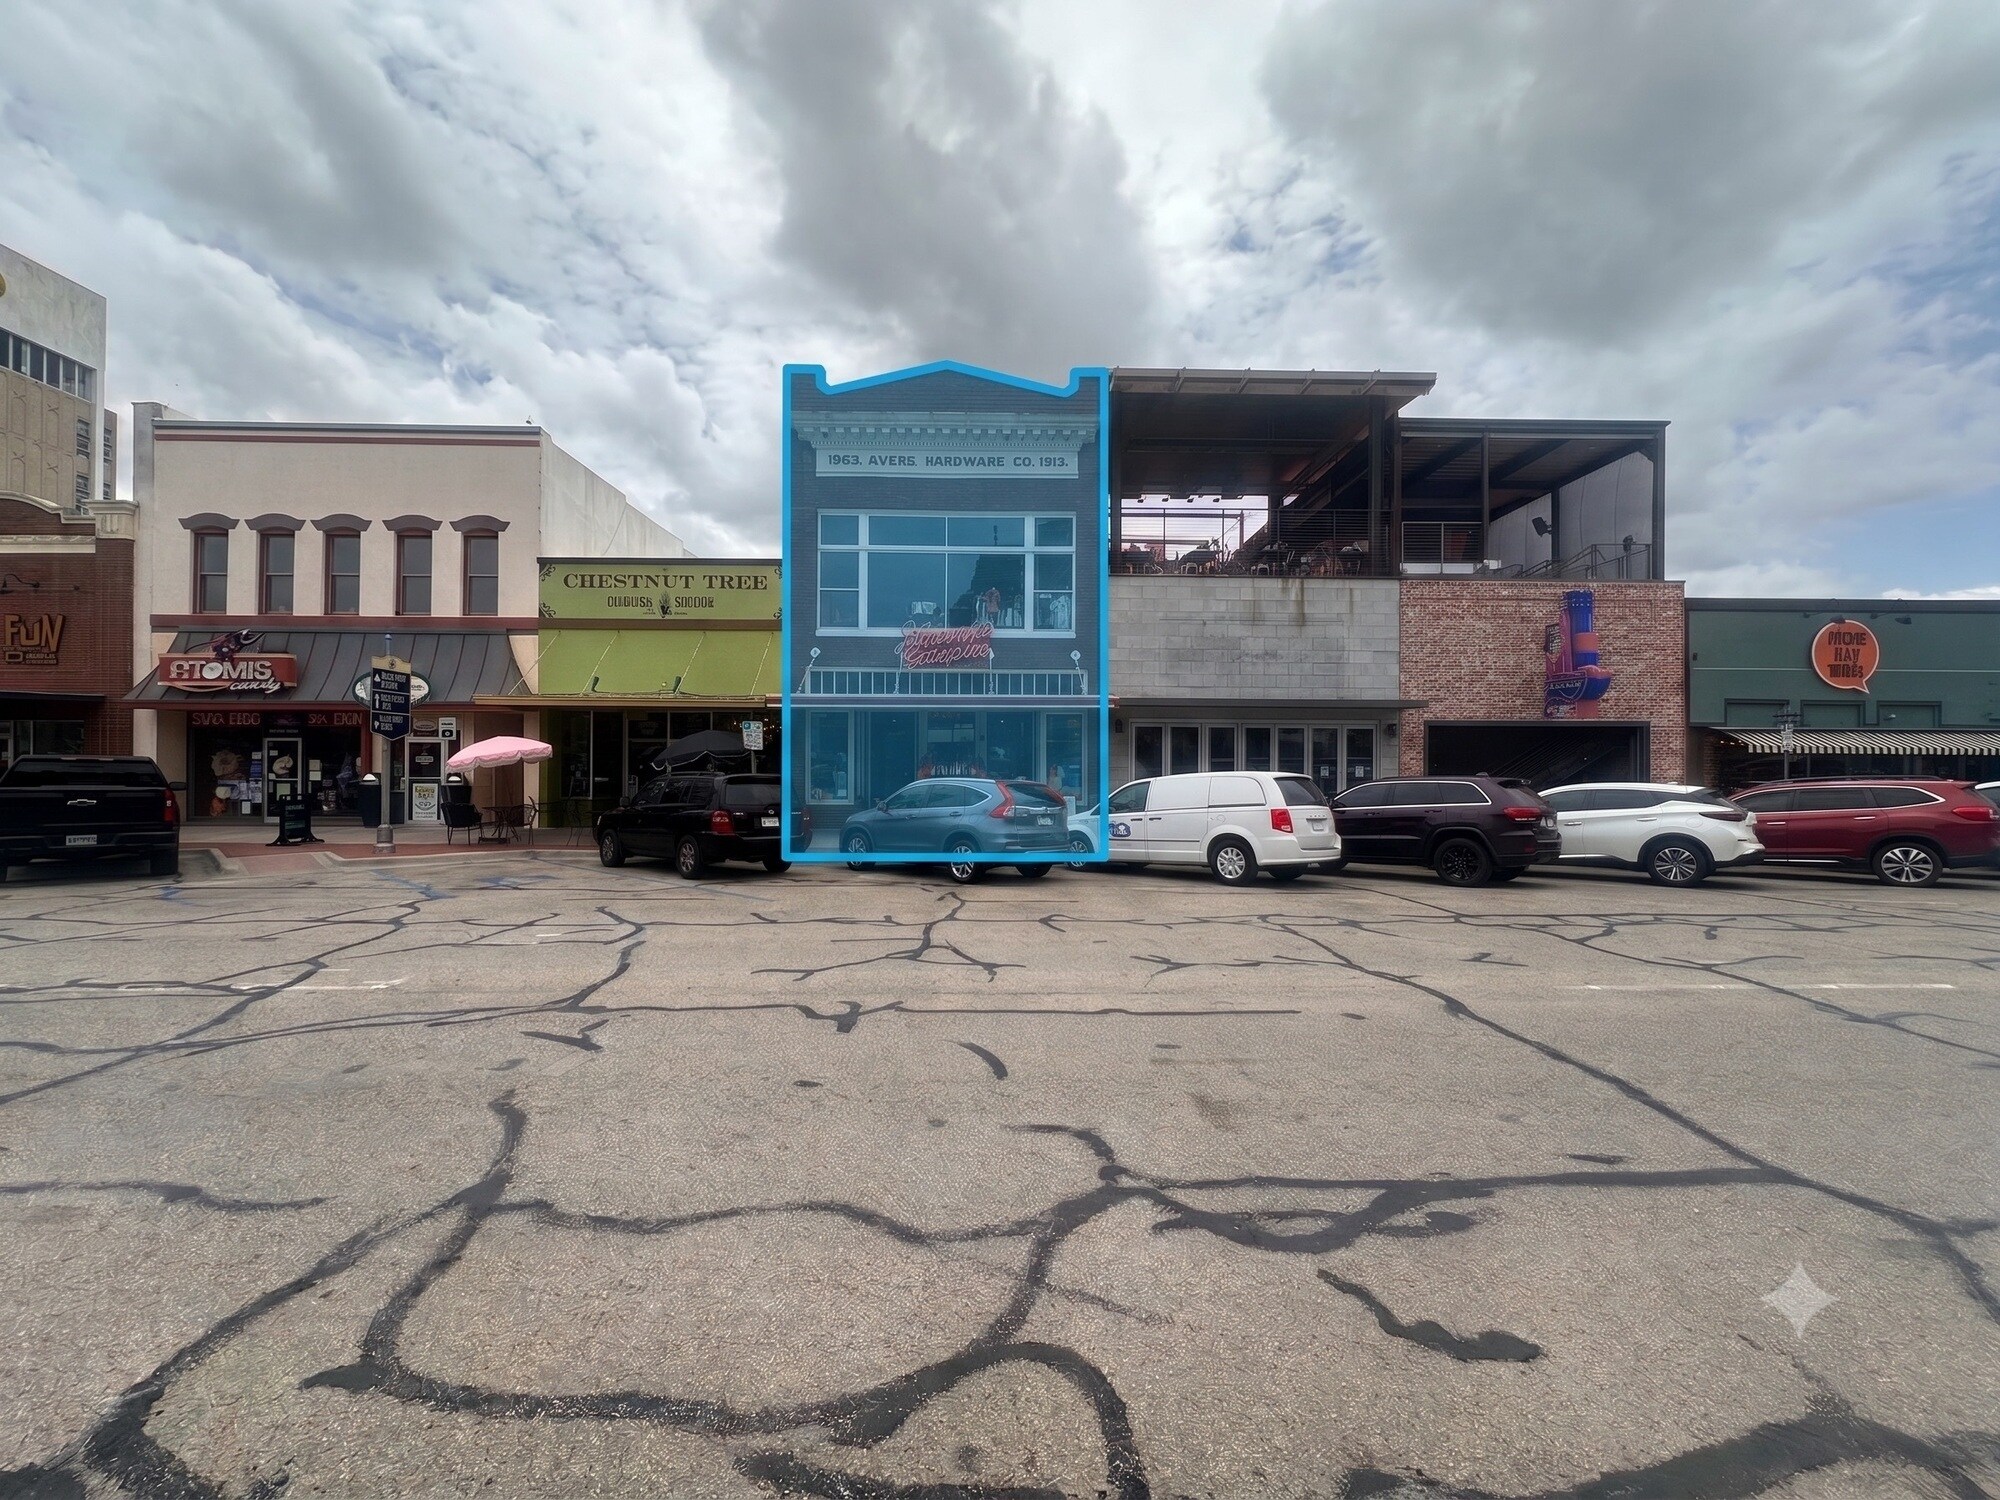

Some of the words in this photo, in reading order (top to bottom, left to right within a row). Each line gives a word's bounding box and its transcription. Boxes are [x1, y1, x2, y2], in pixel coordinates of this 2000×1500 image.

[925, 456, 1005, 468] HARDWARE
[1012, 457, 1035, 468] CO.
[1038, 457, 1069, 468] 1913.
[563, 573, 695, 589] CHESTNUT
[703, 574, 768, 590] TREE
[229, 676, 281, 694] candy
